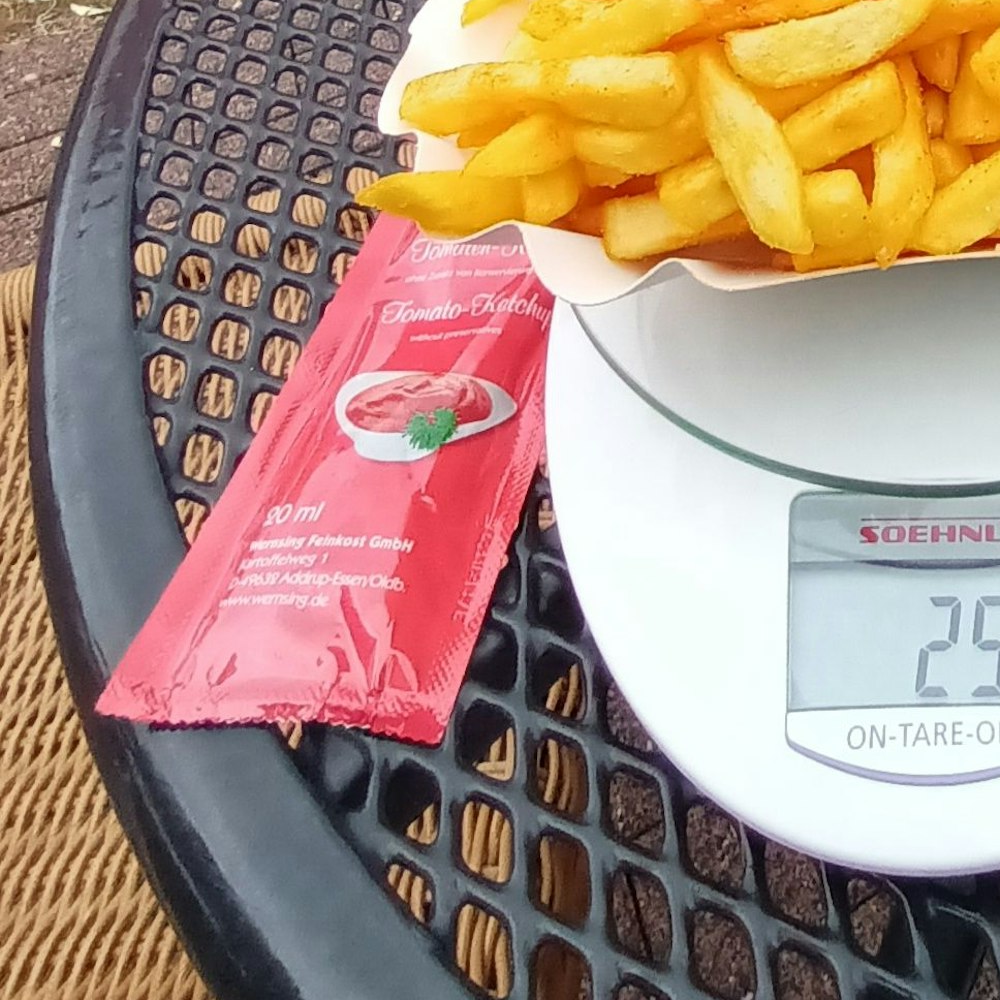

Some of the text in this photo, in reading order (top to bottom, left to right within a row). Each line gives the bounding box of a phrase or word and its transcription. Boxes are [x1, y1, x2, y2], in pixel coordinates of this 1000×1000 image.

[262, 501, 326, 528] 20 ml
[307, 534, 367, 549] Feinkost
[368, 535, 415, 553] GmbH
[320, 552, 329, 565] 1
